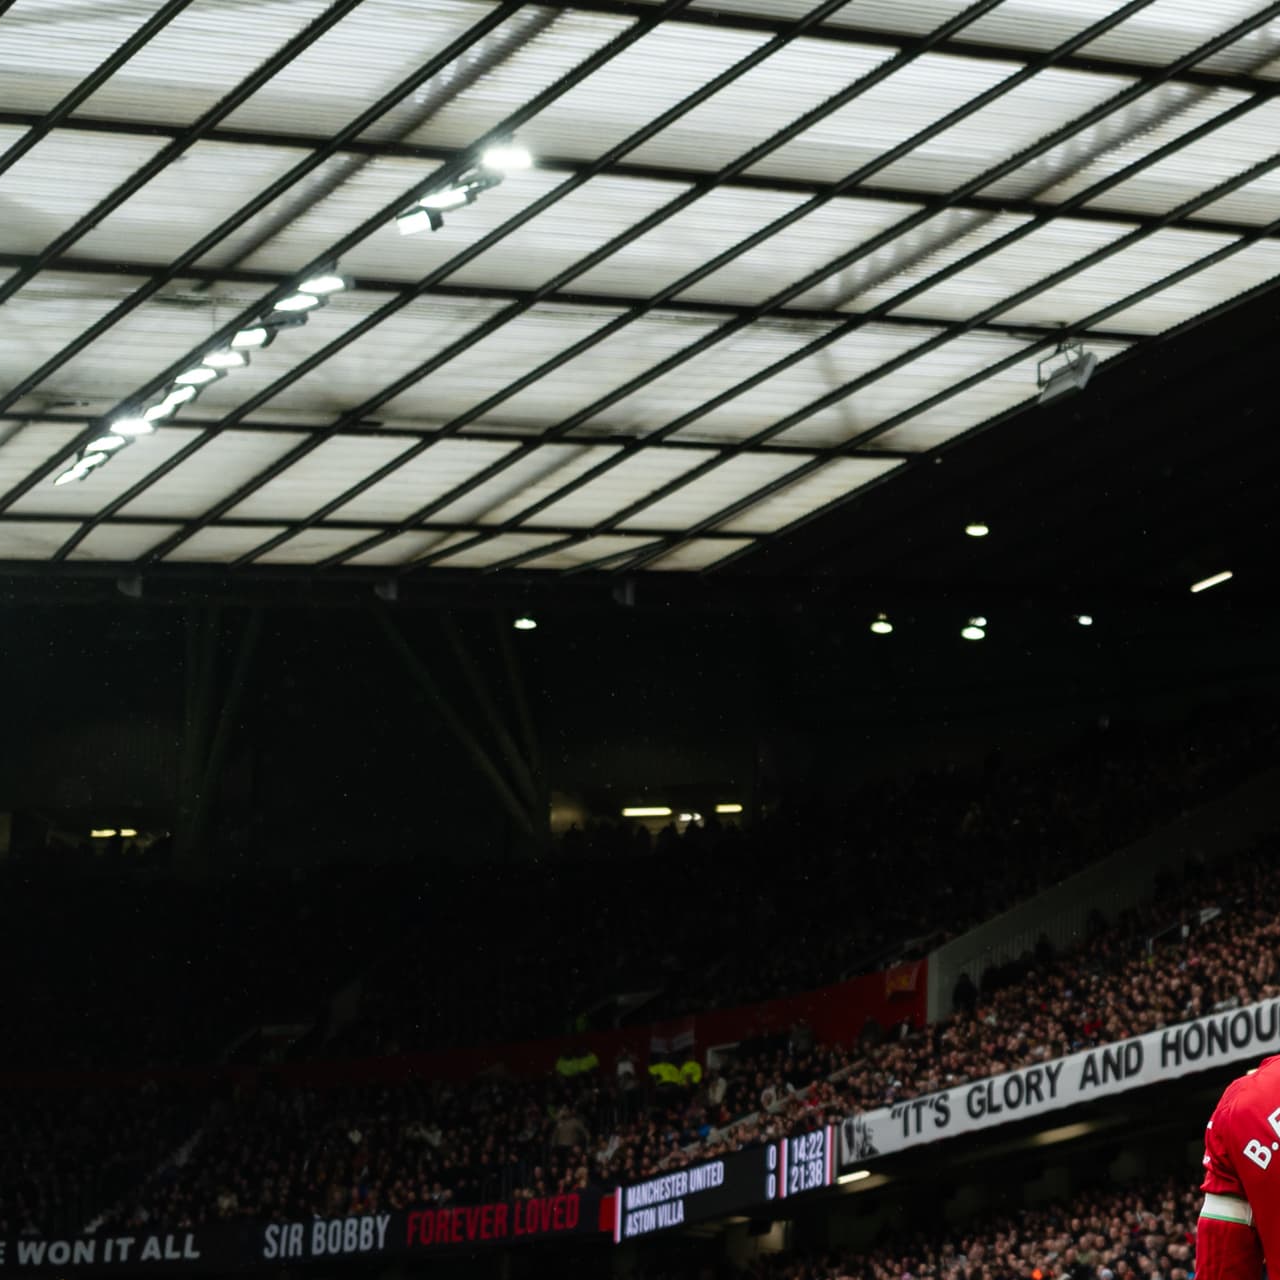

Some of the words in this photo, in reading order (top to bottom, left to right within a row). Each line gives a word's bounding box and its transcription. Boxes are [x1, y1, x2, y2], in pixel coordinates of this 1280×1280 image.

[966, 1061, 1065, 1120] GLORY
[1078, 1040, 1144, 1091] AND
[626, 1171, 688, 1211] MANCHESTER
[689, 1160, 725, 1192] UNITED
[768, 1145, 777, 1171] 0
[791, 1130, 825, 1163] 14:22
[263, 1221, 305, 1259] SIR
[310, 1213, 392, 1257] BOBBY
[406, 1201, 510, 1249] FOREVER
[512, 1193, 581, 1236] LOVED
[625, 1206, 657, 1237] ASTON
[657, 1199, 685, 1229] VILLA
[767, 1173, 776, 1201] 0
[16, 1238, 97, 1267] WON
[102, 1236, 136, 1264] IT
[139, 1232, 201, 1262] ALL
